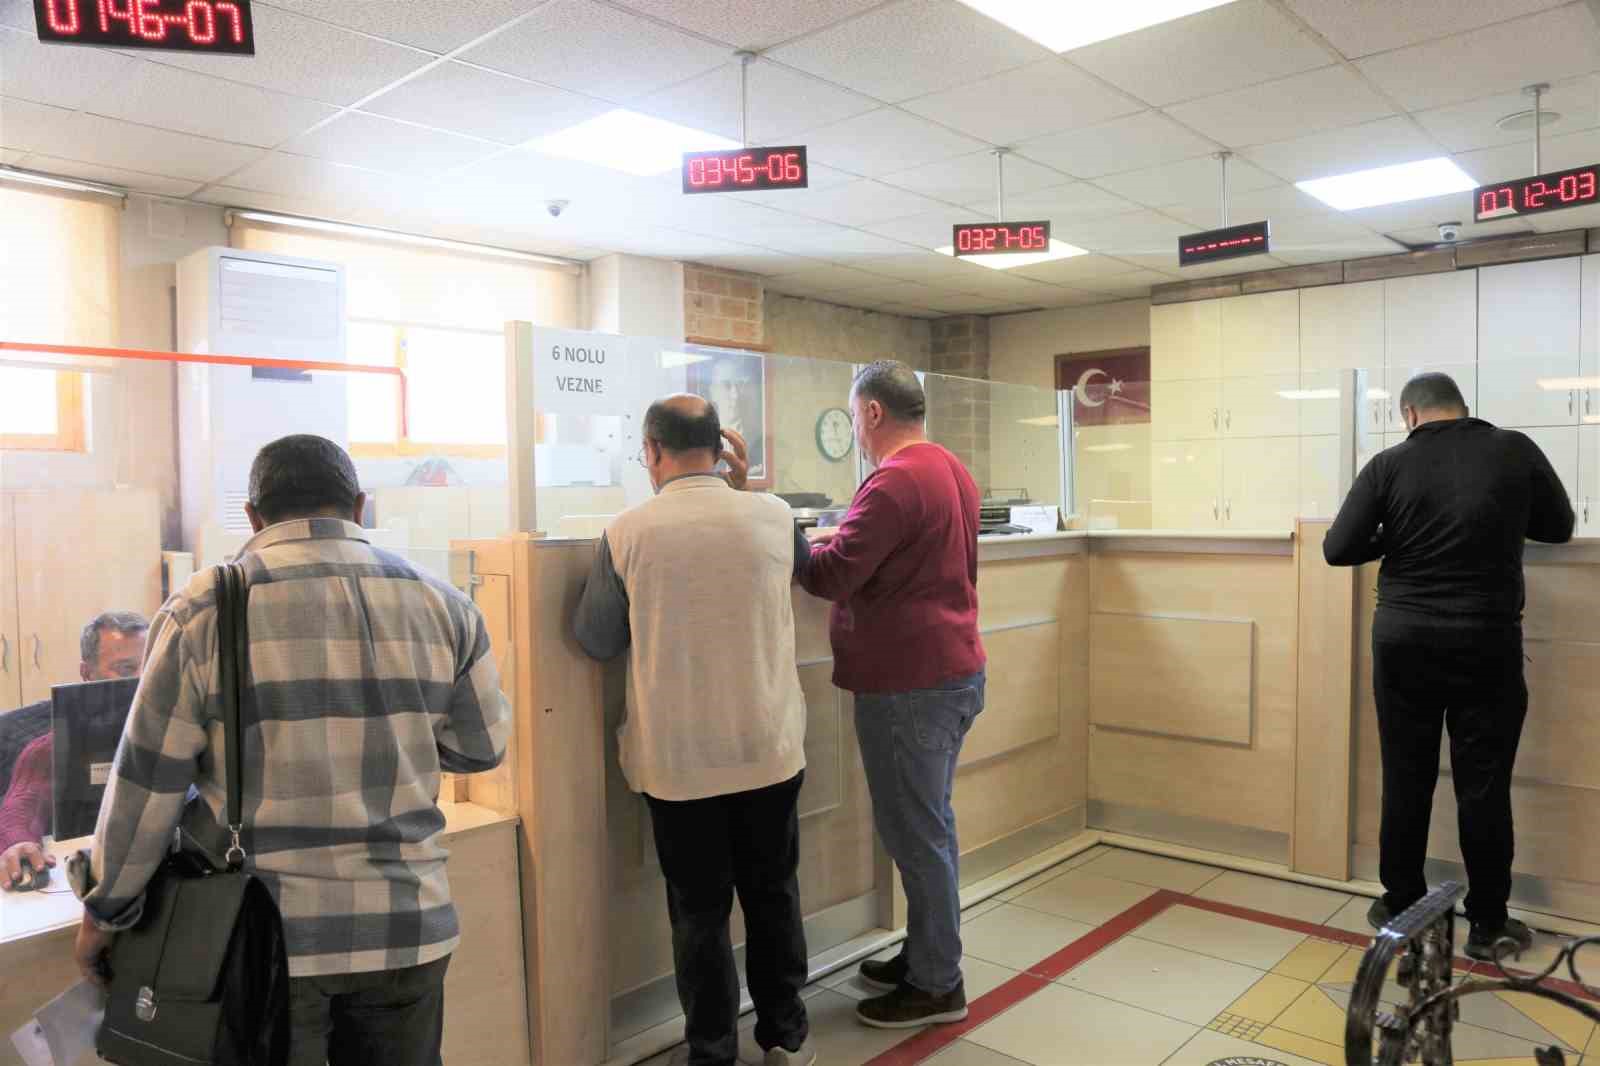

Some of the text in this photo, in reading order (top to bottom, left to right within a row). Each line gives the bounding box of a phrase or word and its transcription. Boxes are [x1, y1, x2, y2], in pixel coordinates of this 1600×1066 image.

[958, 226, 1045, 251] 0327-05
[551, 345, 606, 364] 6 NOLU
[555, 375, 604, 393] VEZNE
